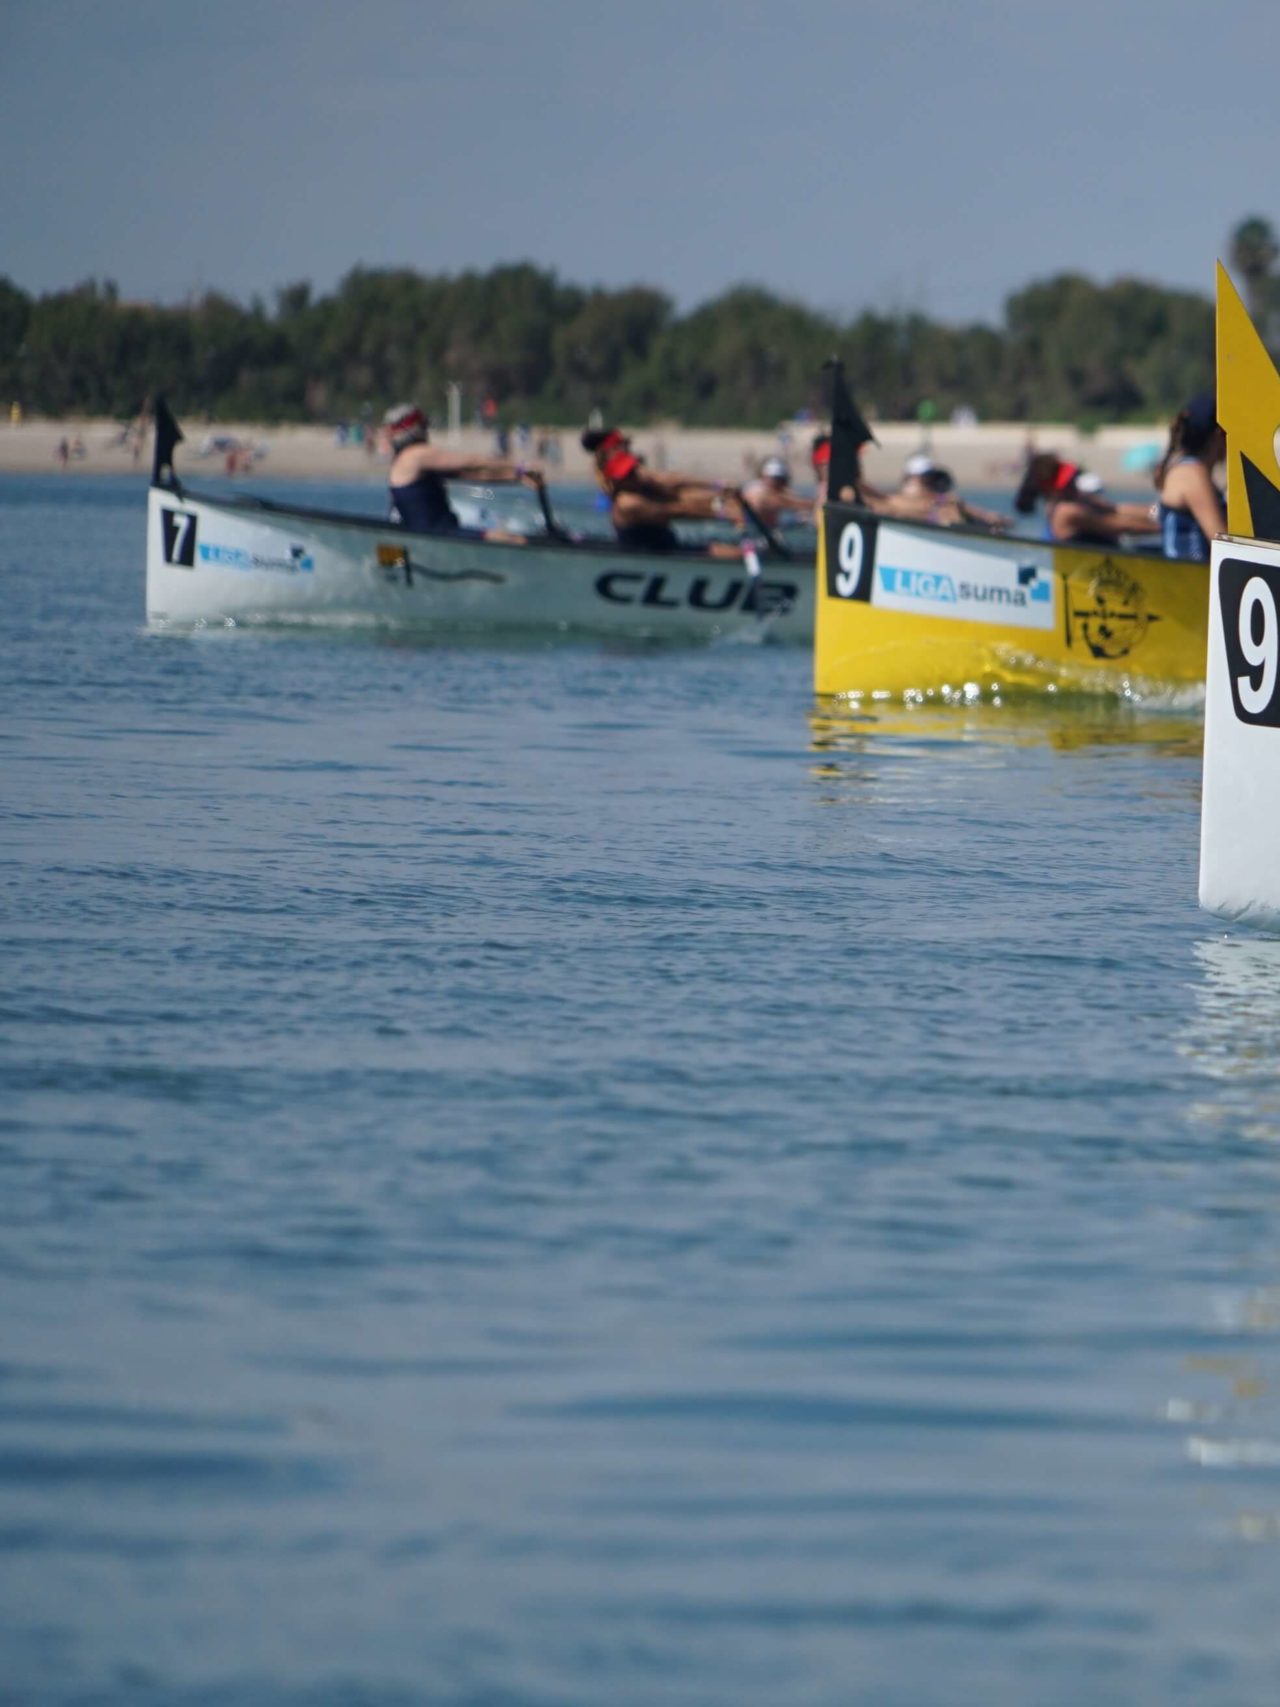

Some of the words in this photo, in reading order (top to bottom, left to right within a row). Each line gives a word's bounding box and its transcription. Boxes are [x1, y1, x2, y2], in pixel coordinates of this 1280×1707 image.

[172, 512, 191, 563] 7
[835, 522, 863, 597] 9
[895, 569, 956, 601] LIGA
[959, 582, 1028, 606] suma
